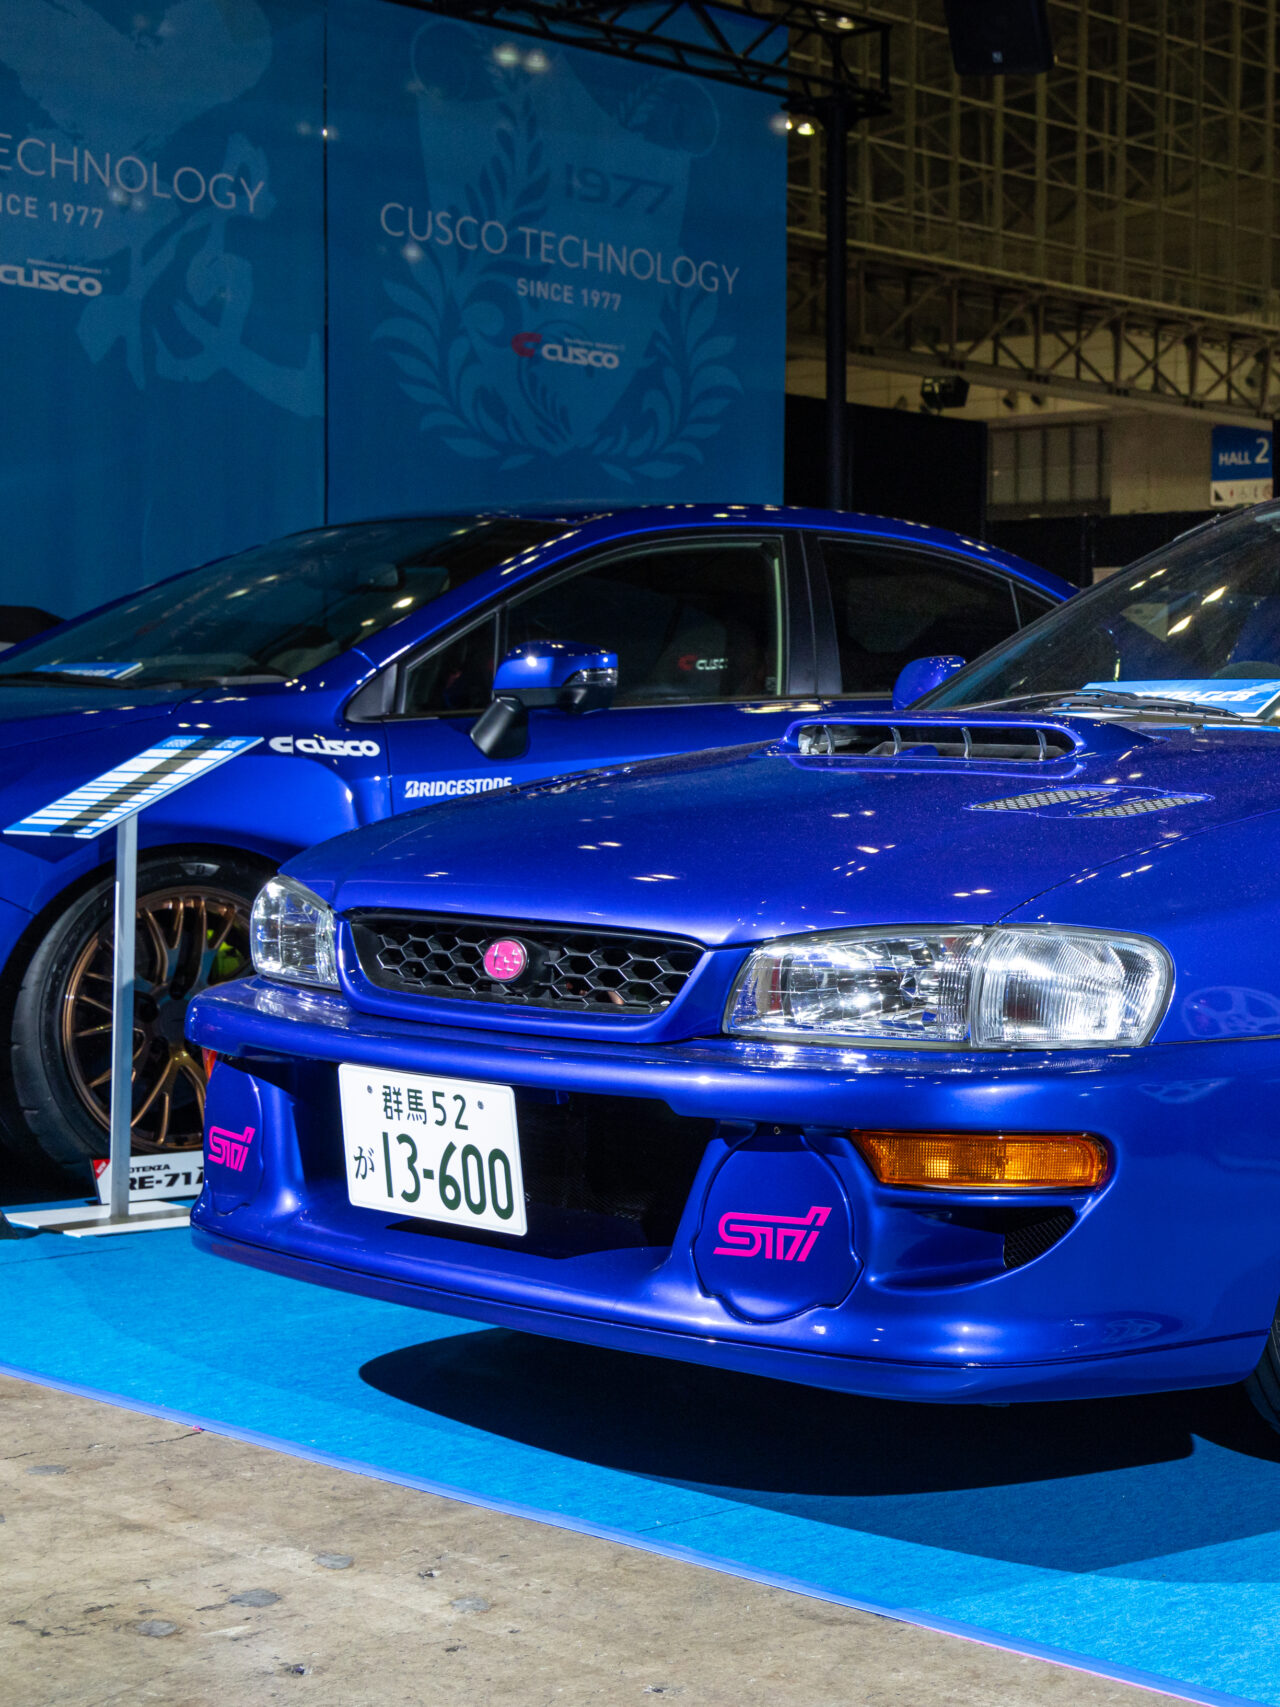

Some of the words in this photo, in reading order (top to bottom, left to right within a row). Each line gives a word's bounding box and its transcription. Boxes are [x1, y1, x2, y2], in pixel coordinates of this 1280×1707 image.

[564, 162, 674, 215] 1977
[0, 192, 39, 219] CE
[49, 201, 104, 229] 1977
[380, 202, 508, 255] CUSCO
[518, 226, 740, 296] TECHNOLOGY
[516, 278, 574, 305] SINCE
[581, 288, 622, 312] 1977
[541, 344, 620, 370] CUSCO
[1218, 451, 1251, 466] HALL
[1254, 437, 1270, 465] 2
[295, 735, 381, 758] CUSCO
[353, 1145, 375, 1181] が
[381, 1131, 515, 1221] 13-600
